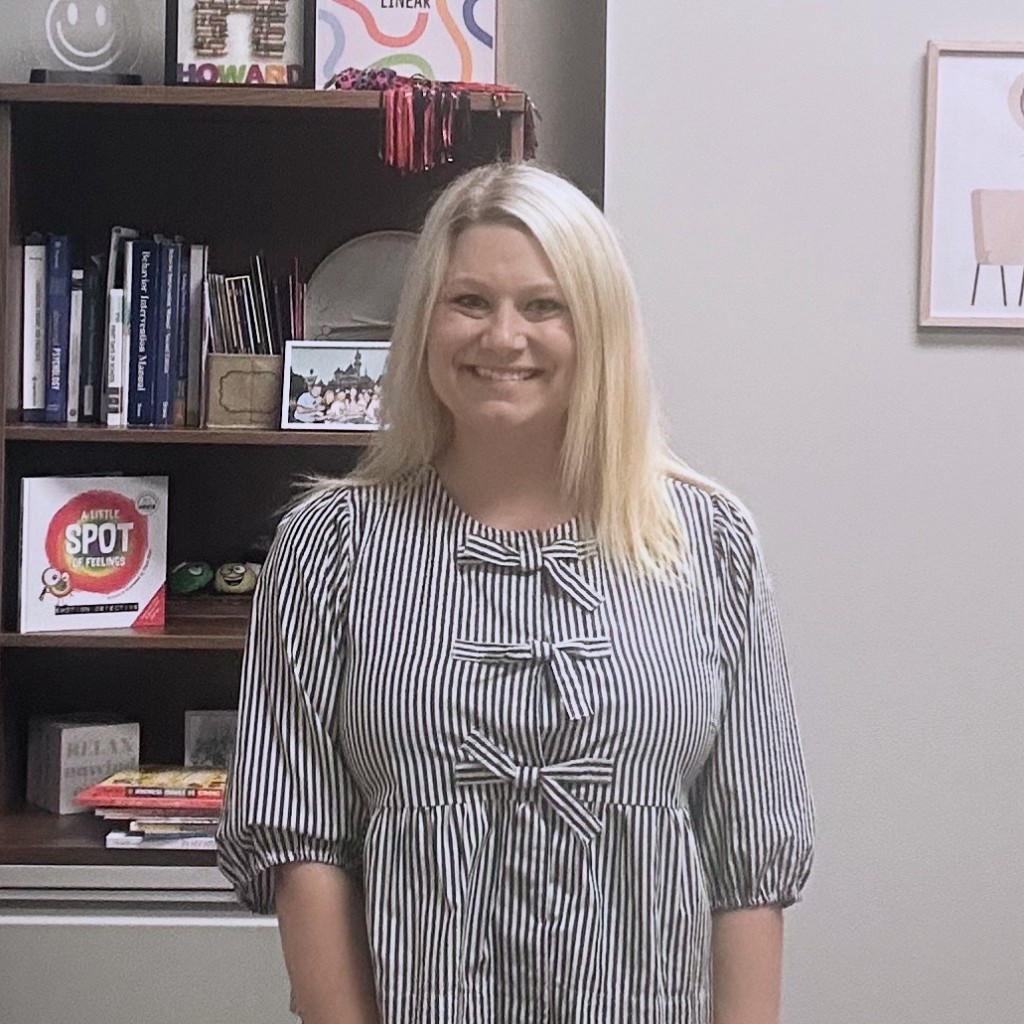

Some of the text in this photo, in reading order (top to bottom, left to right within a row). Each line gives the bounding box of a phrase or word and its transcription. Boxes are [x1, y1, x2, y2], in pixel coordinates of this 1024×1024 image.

[177, 63, 304, 84] HOWARD
[140, 251, 151, 292] Behavior
[138, 295, 149, 352] Intervention
[51, 347, 61, 390] PSYCHOLOGY
[137, 354, 148, 391] Manual
[90, 509, 121, 520] LITTLE
[65, 522, 134, 555] SPOT
[72, 556, 126, 568] OF FEELINGS
